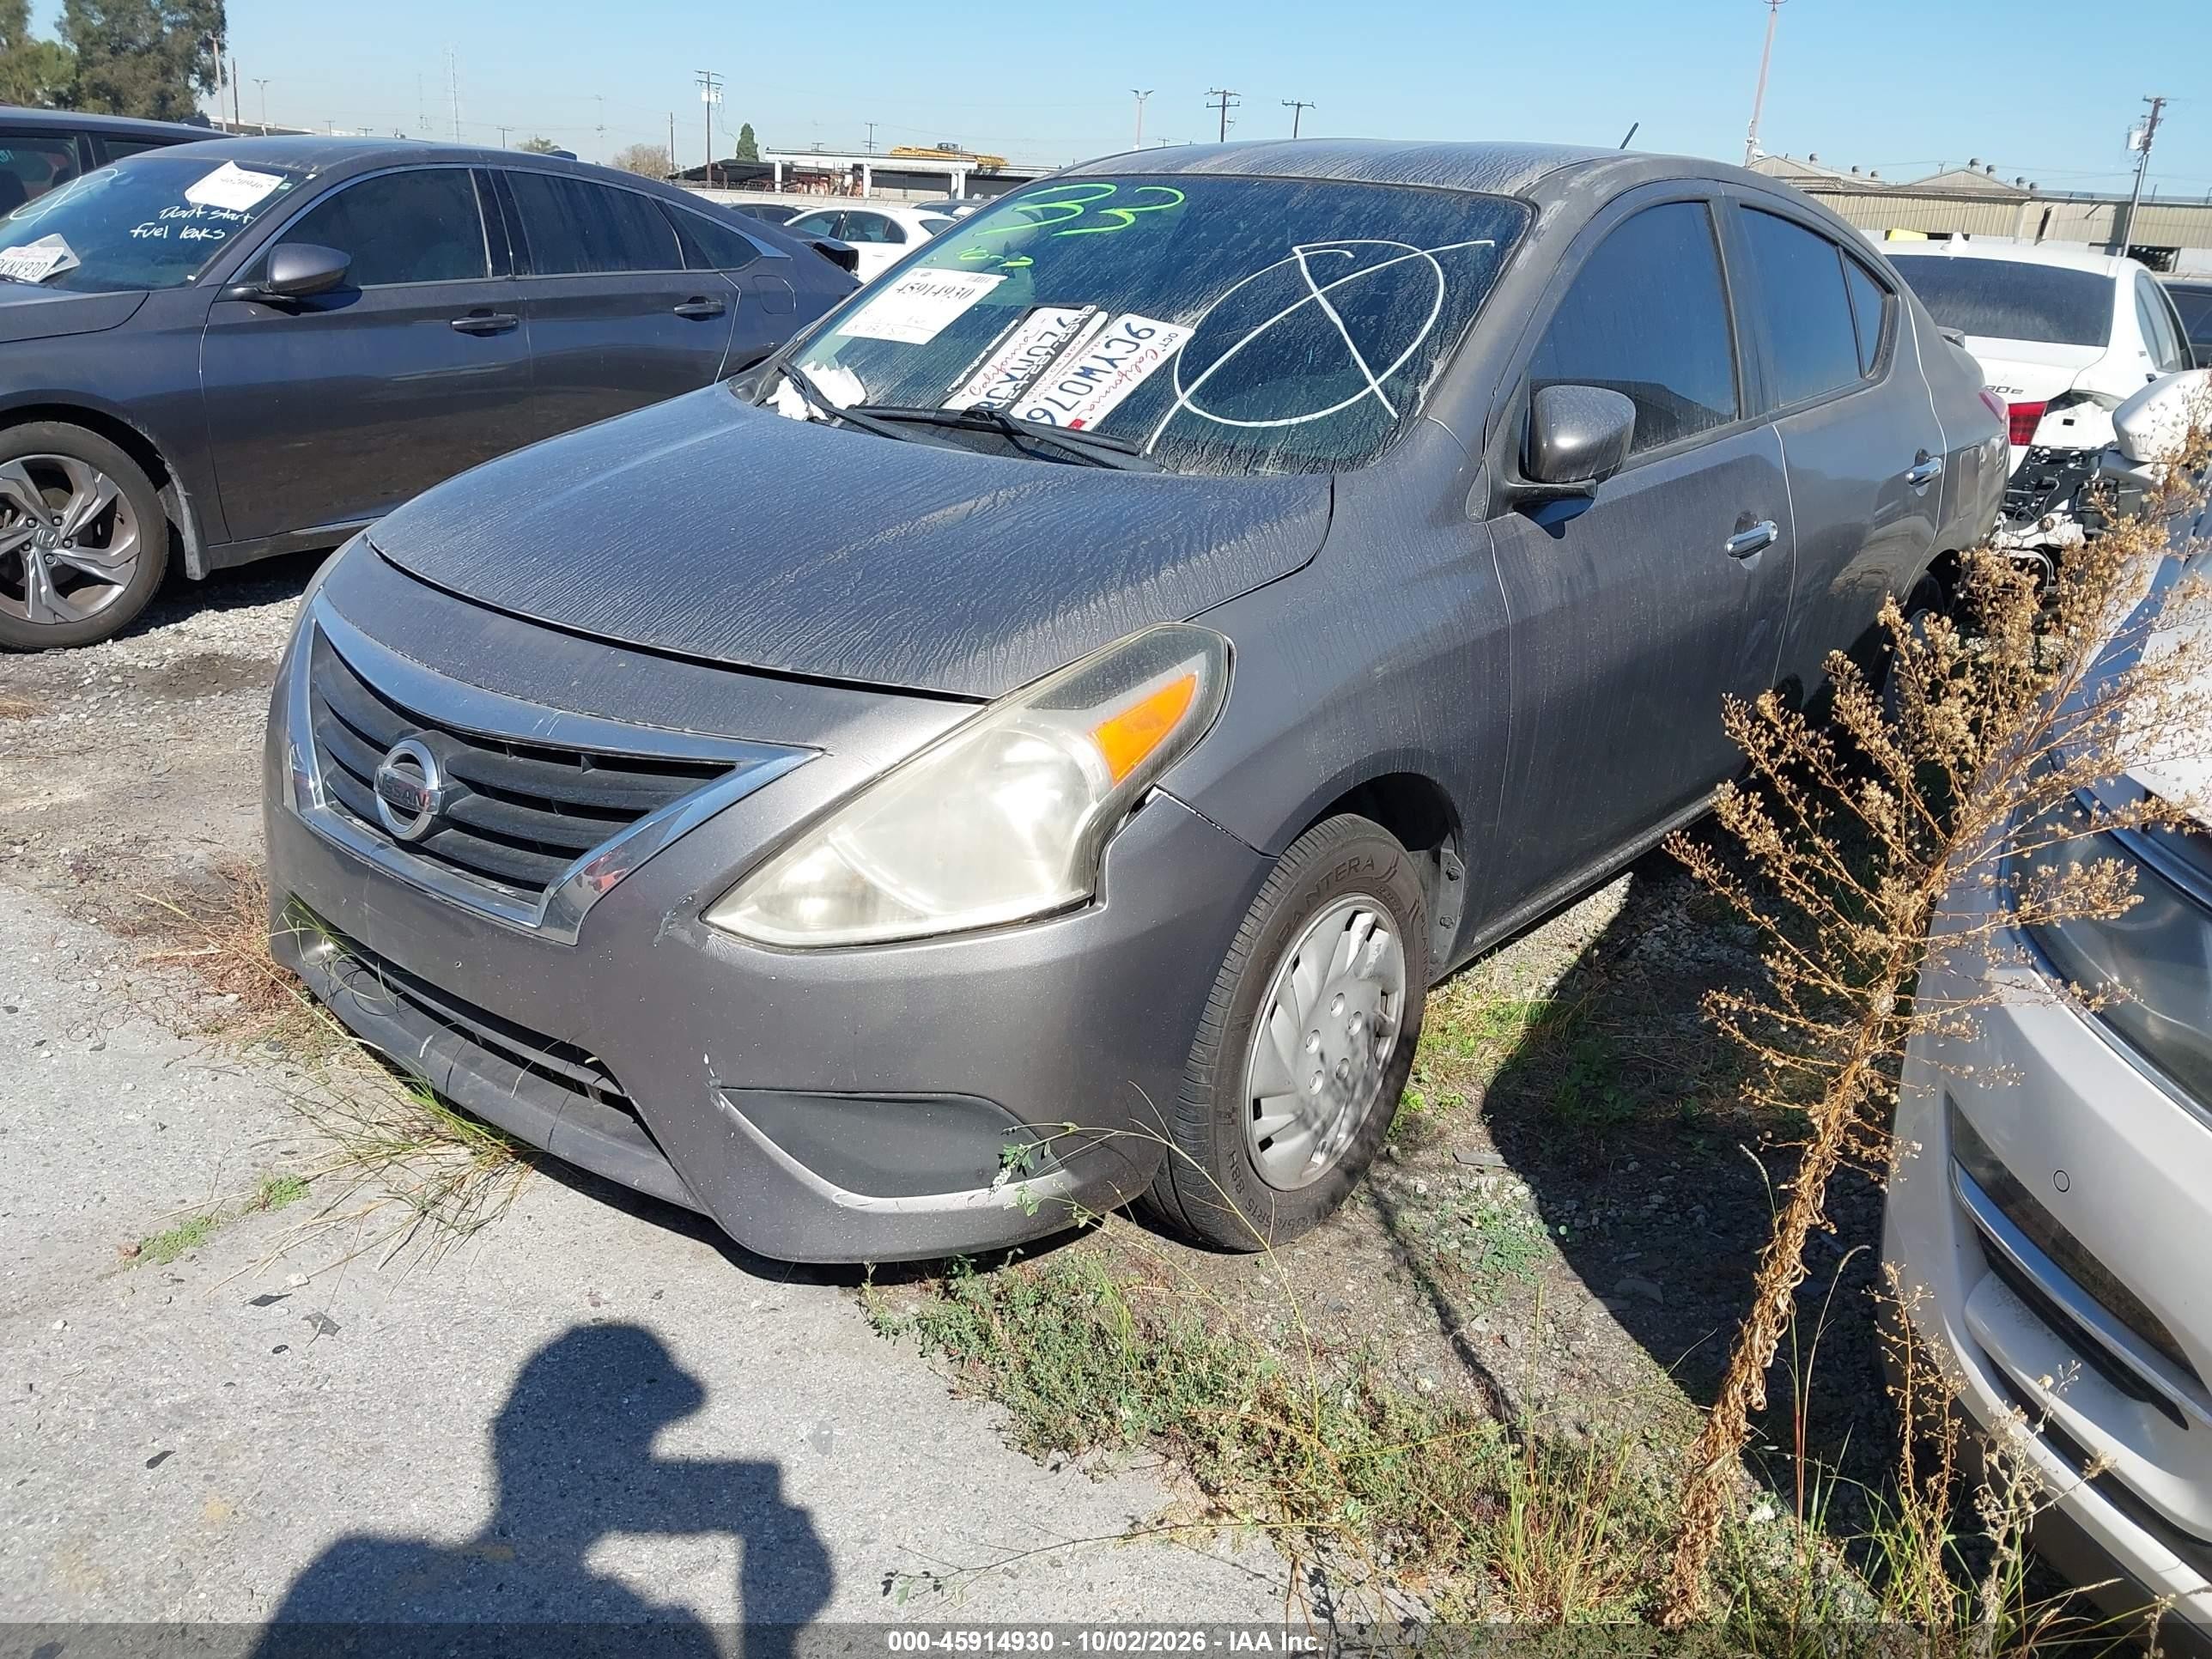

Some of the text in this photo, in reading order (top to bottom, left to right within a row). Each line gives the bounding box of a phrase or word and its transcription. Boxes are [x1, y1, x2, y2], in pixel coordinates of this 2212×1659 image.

[207, 209, 255, 224] start
[179, 224, 226, 241] leaks
[896, 281, 976, 301] 45914930
[1158, 332, 1179, 348] OCT
[969, 330, 1040, 396] California
[1026, 322, 1156, 426] 9CYW076
[1077, 348, 1159, 416] California
[378, 770, 430, 810] NISSAN
